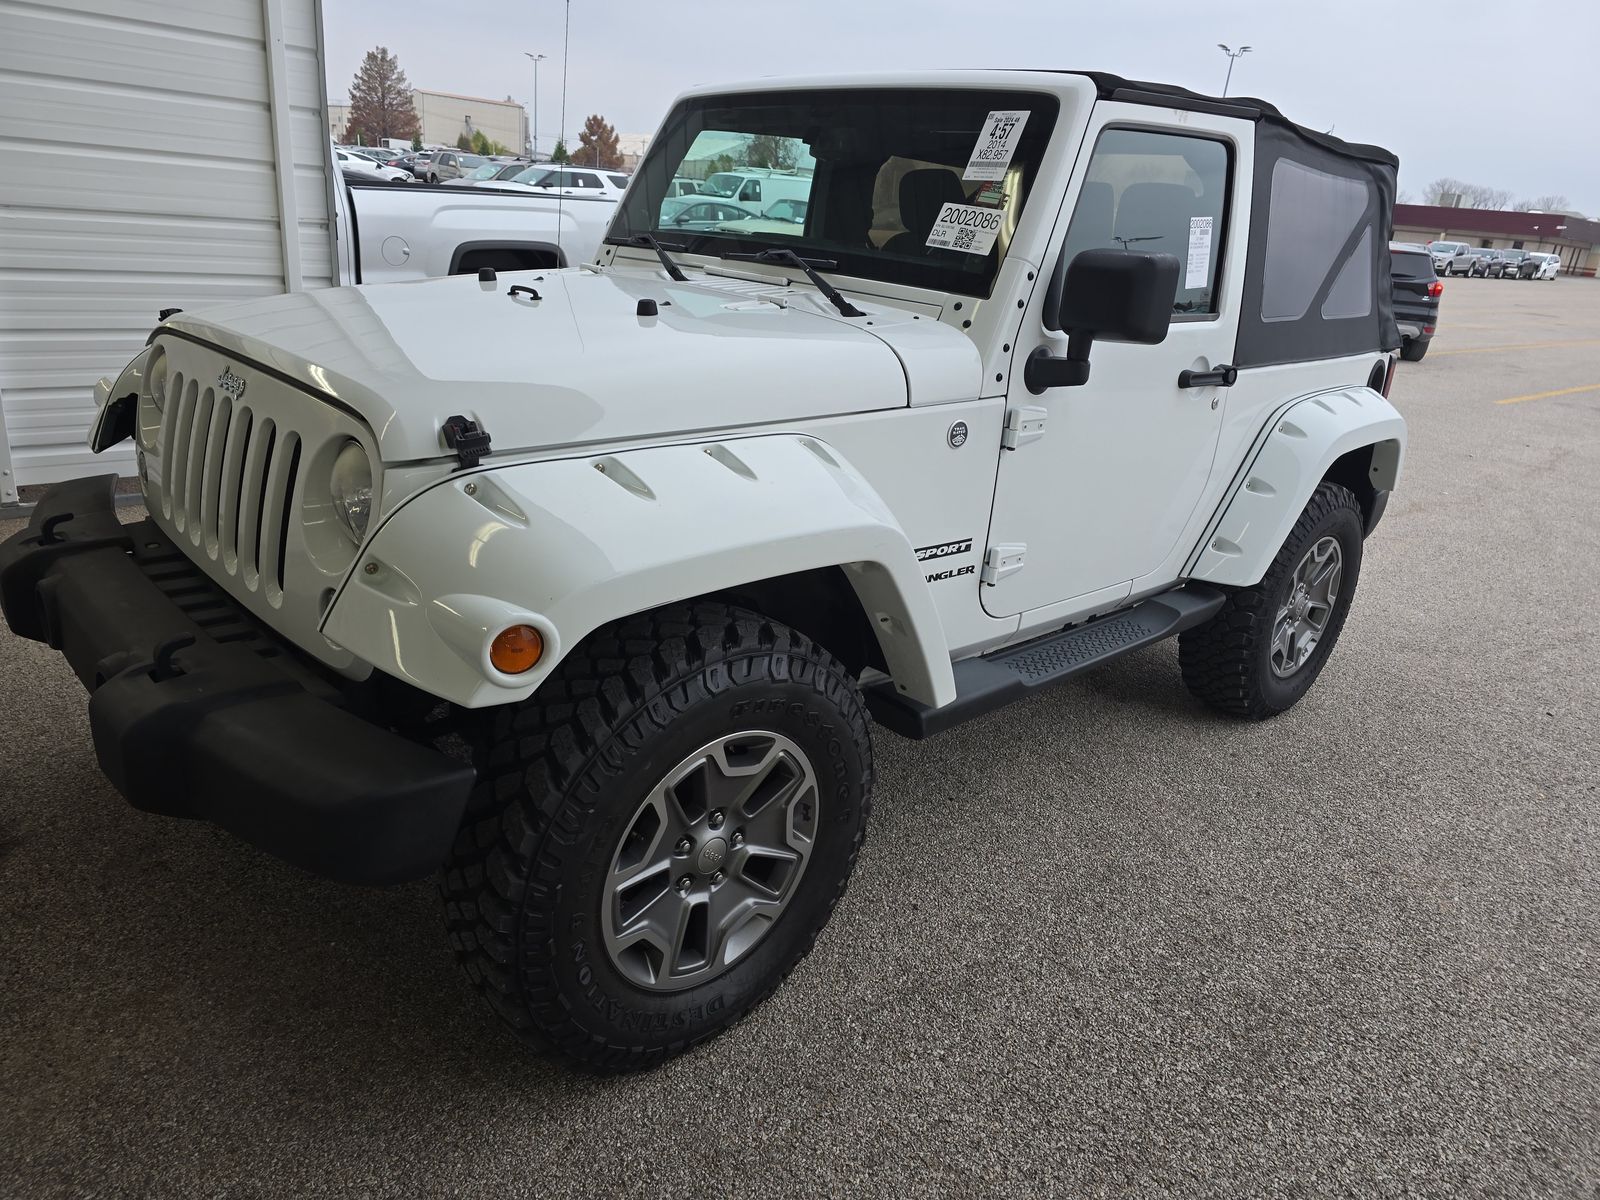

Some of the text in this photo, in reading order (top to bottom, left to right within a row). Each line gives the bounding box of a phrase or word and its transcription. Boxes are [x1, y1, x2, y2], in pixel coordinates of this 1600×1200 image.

[989, 123, 1016, 140] 4:57
[986, 140, 1007, 149] 2014
[976, 149, 1009, 160] X82,957
[940, 207, 1002, 230] 2002086
[931, 229, 947, 238] DLR
[914, 542, 969, 560] SPORT
[570, 939, 725, 1031] DESTINATION
